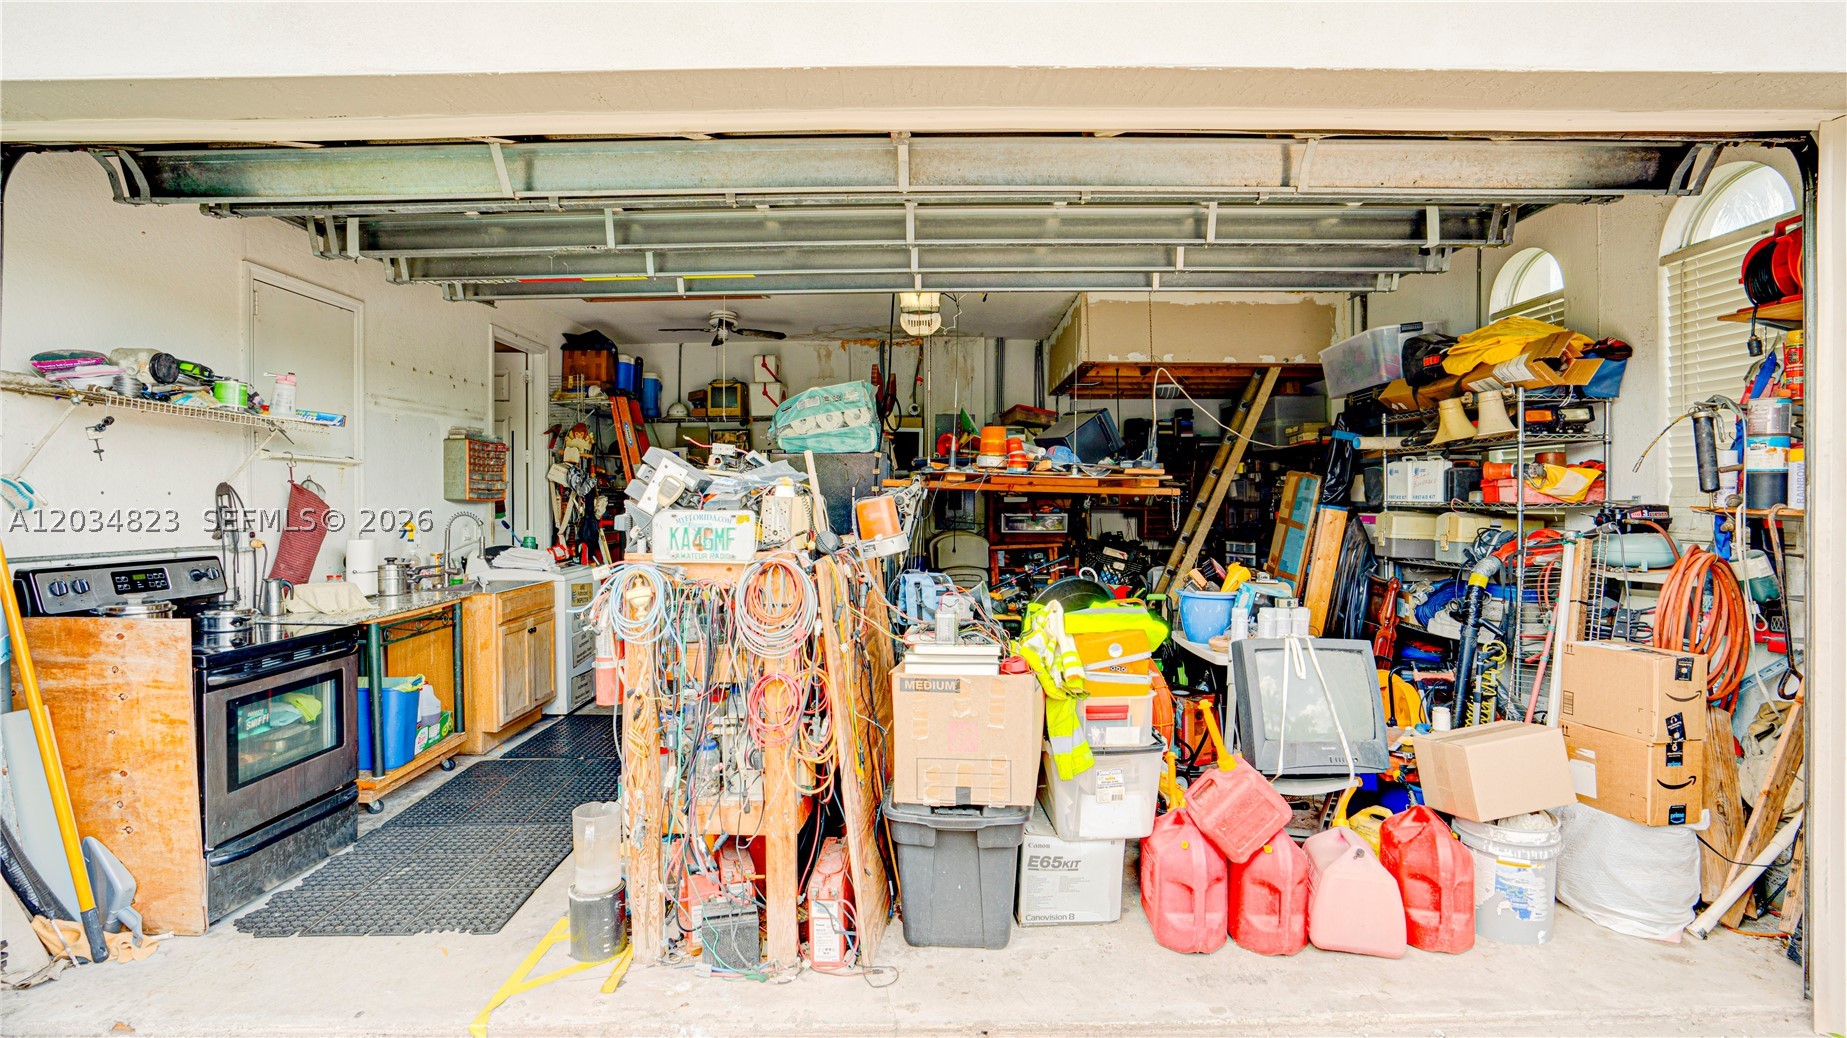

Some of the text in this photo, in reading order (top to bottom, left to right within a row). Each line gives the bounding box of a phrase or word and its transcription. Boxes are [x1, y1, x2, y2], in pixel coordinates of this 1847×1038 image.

[675, 552, 708, 560] AMATEUR
[904, 680, 956, 691] MEDIUM
[1670, 811, 1685, 821] prime
[1025, 912, 1075, 921] Canovision 8
